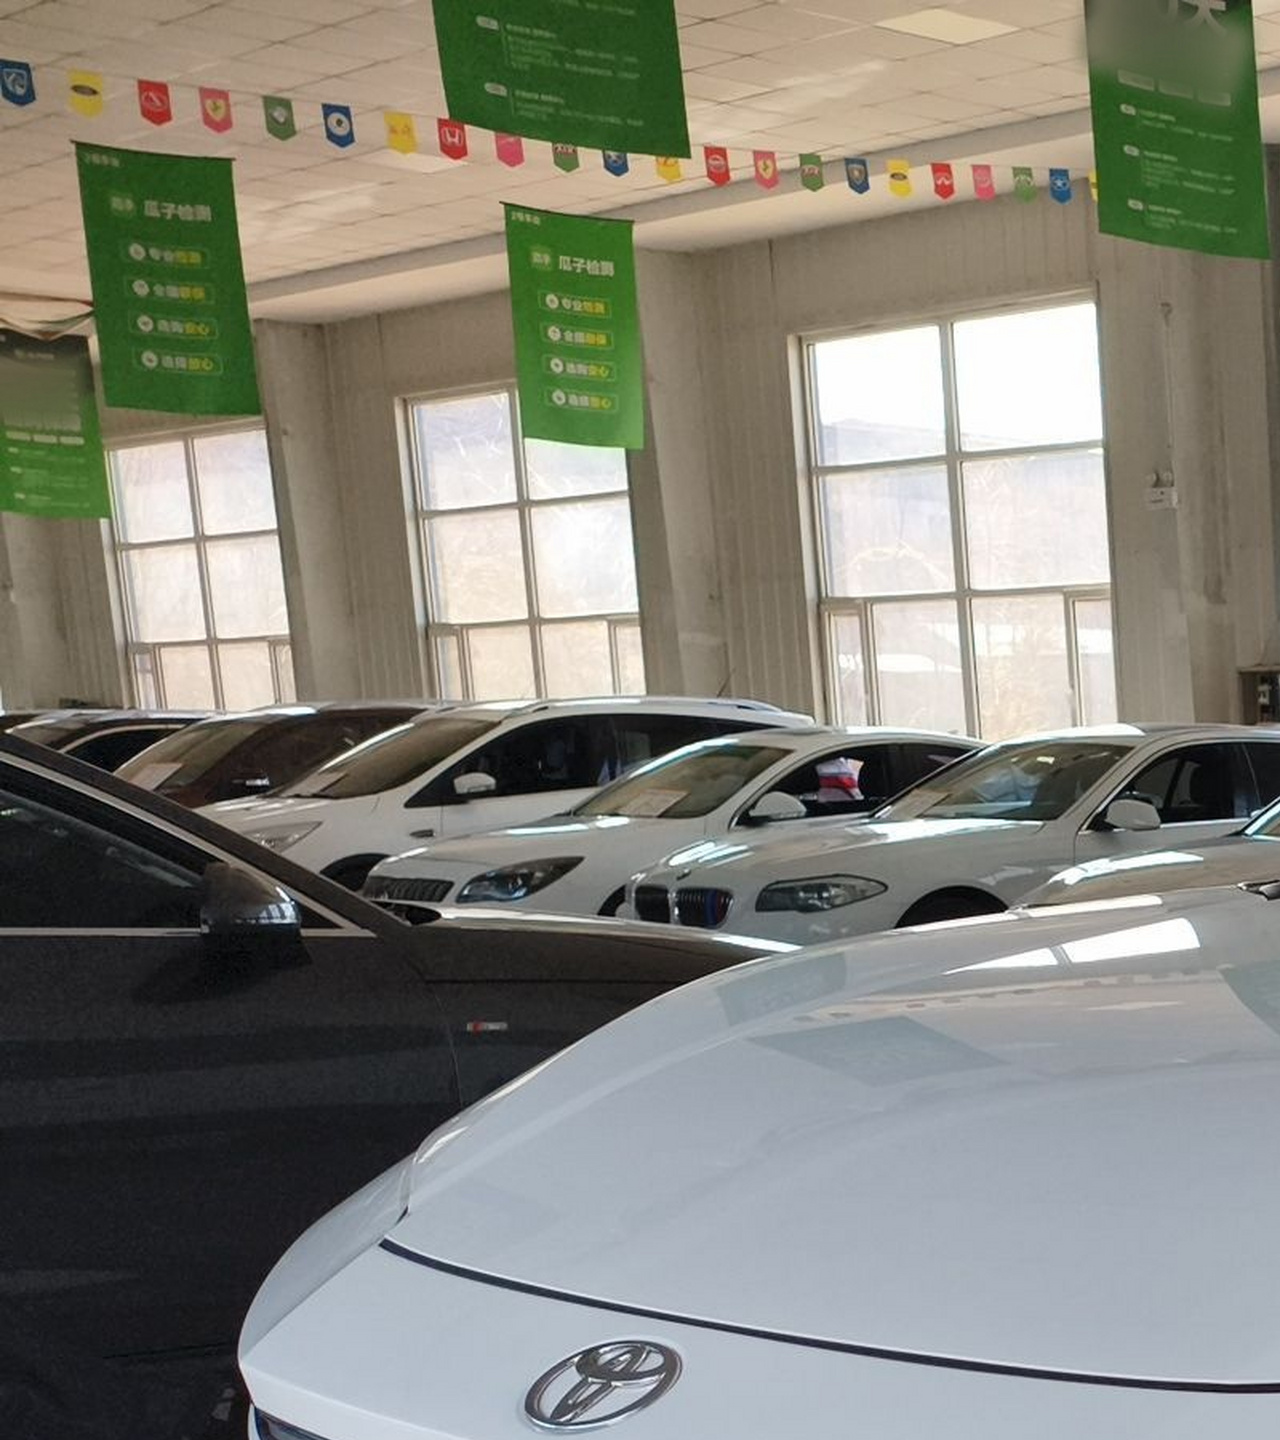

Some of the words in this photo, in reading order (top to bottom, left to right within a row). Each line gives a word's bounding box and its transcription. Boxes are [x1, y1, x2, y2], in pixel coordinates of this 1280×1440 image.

[144, 199, 212, 223] 瓜子检测
[559, 255, 614, 278] 瓜子检测
